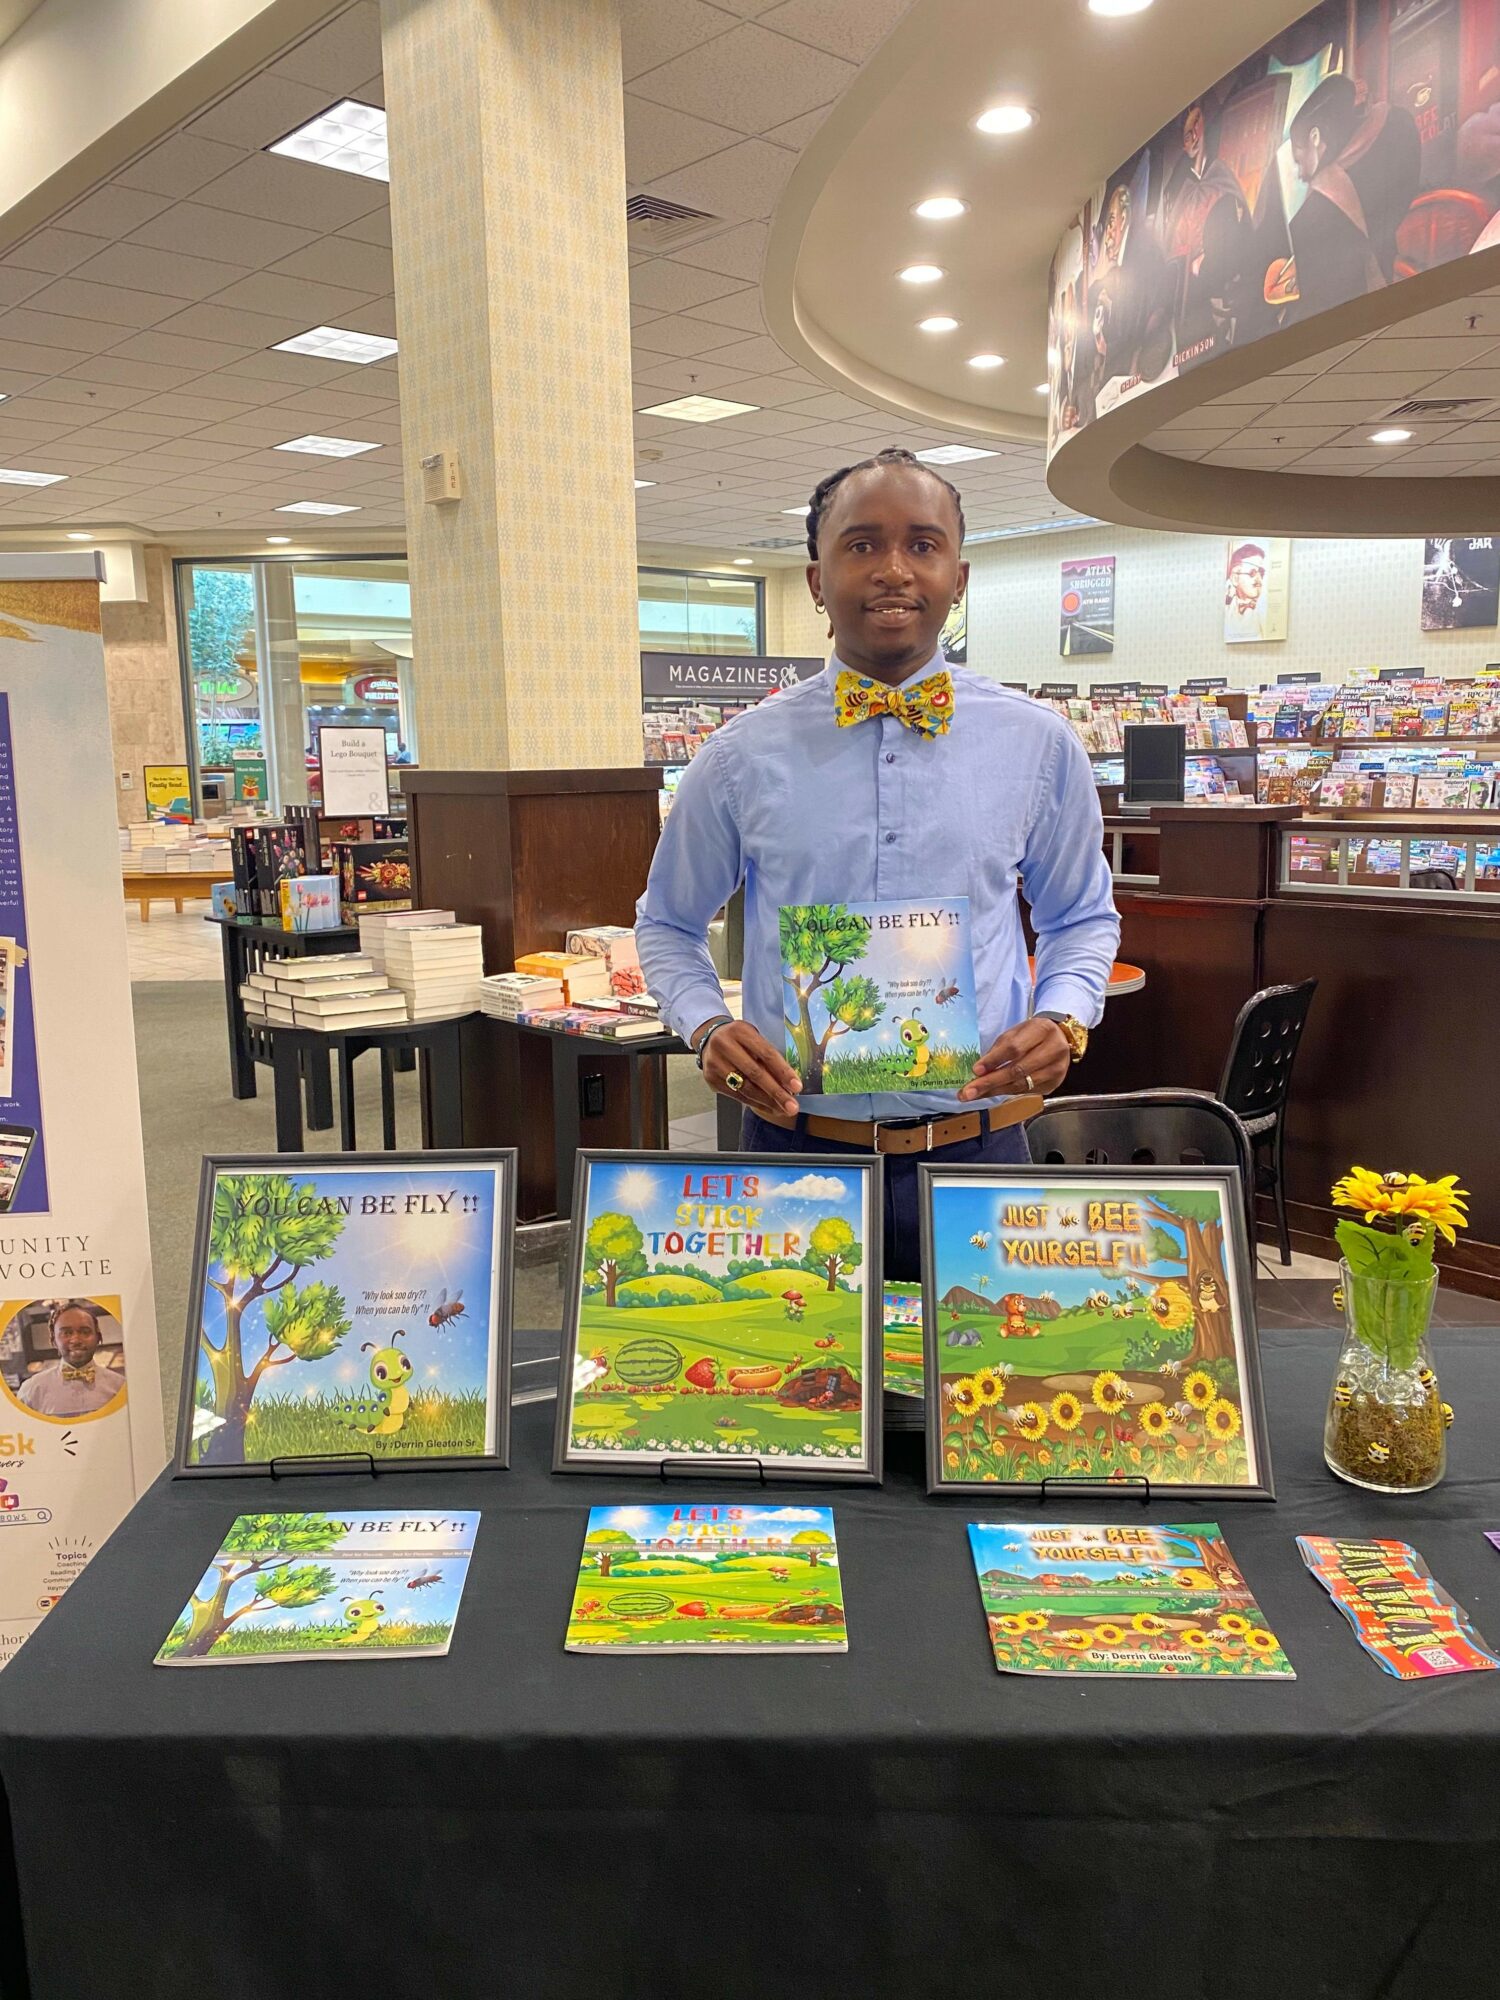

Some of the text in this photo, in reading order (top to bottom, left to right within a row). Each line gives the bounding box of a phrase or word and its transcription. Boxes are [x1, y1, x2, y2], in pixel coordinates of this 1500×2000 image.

[1173, 337, 1214, 366] DICKINSON
[1469, 537, 1493, 550] JAR
[1085, 564, 1112, 576] ATLAS
[669, 664, 778, 684] MAGAZINES
[1345, 707, 1367, 717] MANGA
[342, 740, 360, 748] Build
[331, 750, 378, 759] Lego Bouquet
[793, 909, 960, 933] YOU CAN BE FLY !!
[682, 1174, 760, 1200] LET'S
[237, 1190, 480, 1217] YOU CAN BE FLY !!
[674, 1204, 764, 1230] STICK
[1003, 1202, 1141, 1233] JUST BEE
[647, 1231, 801, 1258] TOGETHER
[379, 1290, 394, 1301] look
[394, 1292, 406, 1300] soo
[407, 1290, 427, 1302] dry??
[355, 1305, 374, 1315] When
[375, 1306, 386, 1317] you
[387, 1307, 401, 1315] can
[402, 1305, 410, 1314] be
[375, 1440, 388, 1450] By
[426, 1439, 464, 1449] Gleaton
[466, 1438, 476, 1447] Sr
[251, 1519, 468, 1534] YOU CAN BE FLY !!
[666, 1523, 745, 1536] STICK
[1031, 1527, 1154, 1545] JUST BEE
[640, 1537, 783, 1551] TOGETHER
[56, 1552, 87, 1560] Topics
[1376, 1603, 1426, 1618] Swagg
[1391, 1632, 1441, 1646] Swagg
[1092, 1651, 1192, 1662] By: Derrin Gleaton
